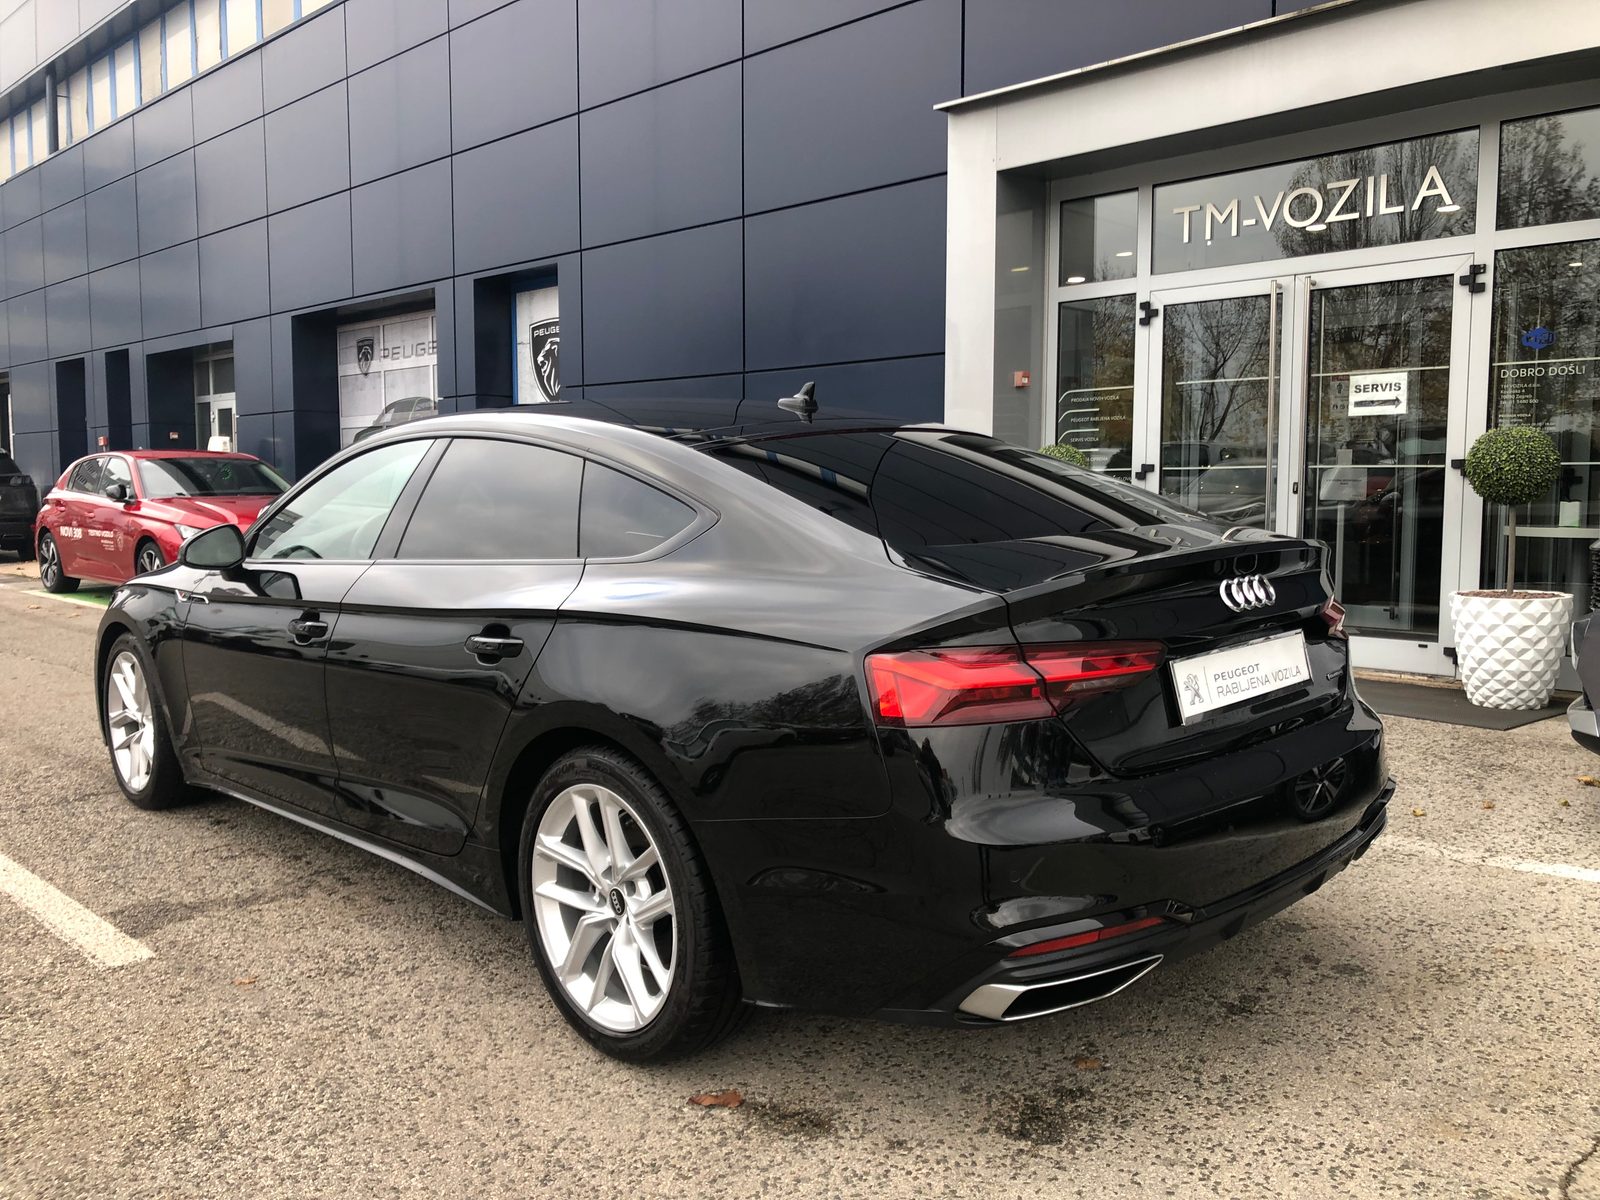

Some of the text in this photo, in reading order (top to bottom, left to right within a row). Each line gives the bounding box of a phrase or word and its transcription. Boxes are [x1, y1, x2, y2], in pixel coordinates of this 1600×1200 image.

[1173, 165, 1453, 243] TM-VOZILA
[1500, 363, 1586, 379] DOBRO DOŠLI
[1354, 382, 1402, 394] SERVIS
[60, 526, 73, 537] NOVI
[1213, 663, 1260, 682] PEUGEOT
[1216, 675, 1271, 699] RABLJENA
[1272, 665, 1302, 683] VOZILA
